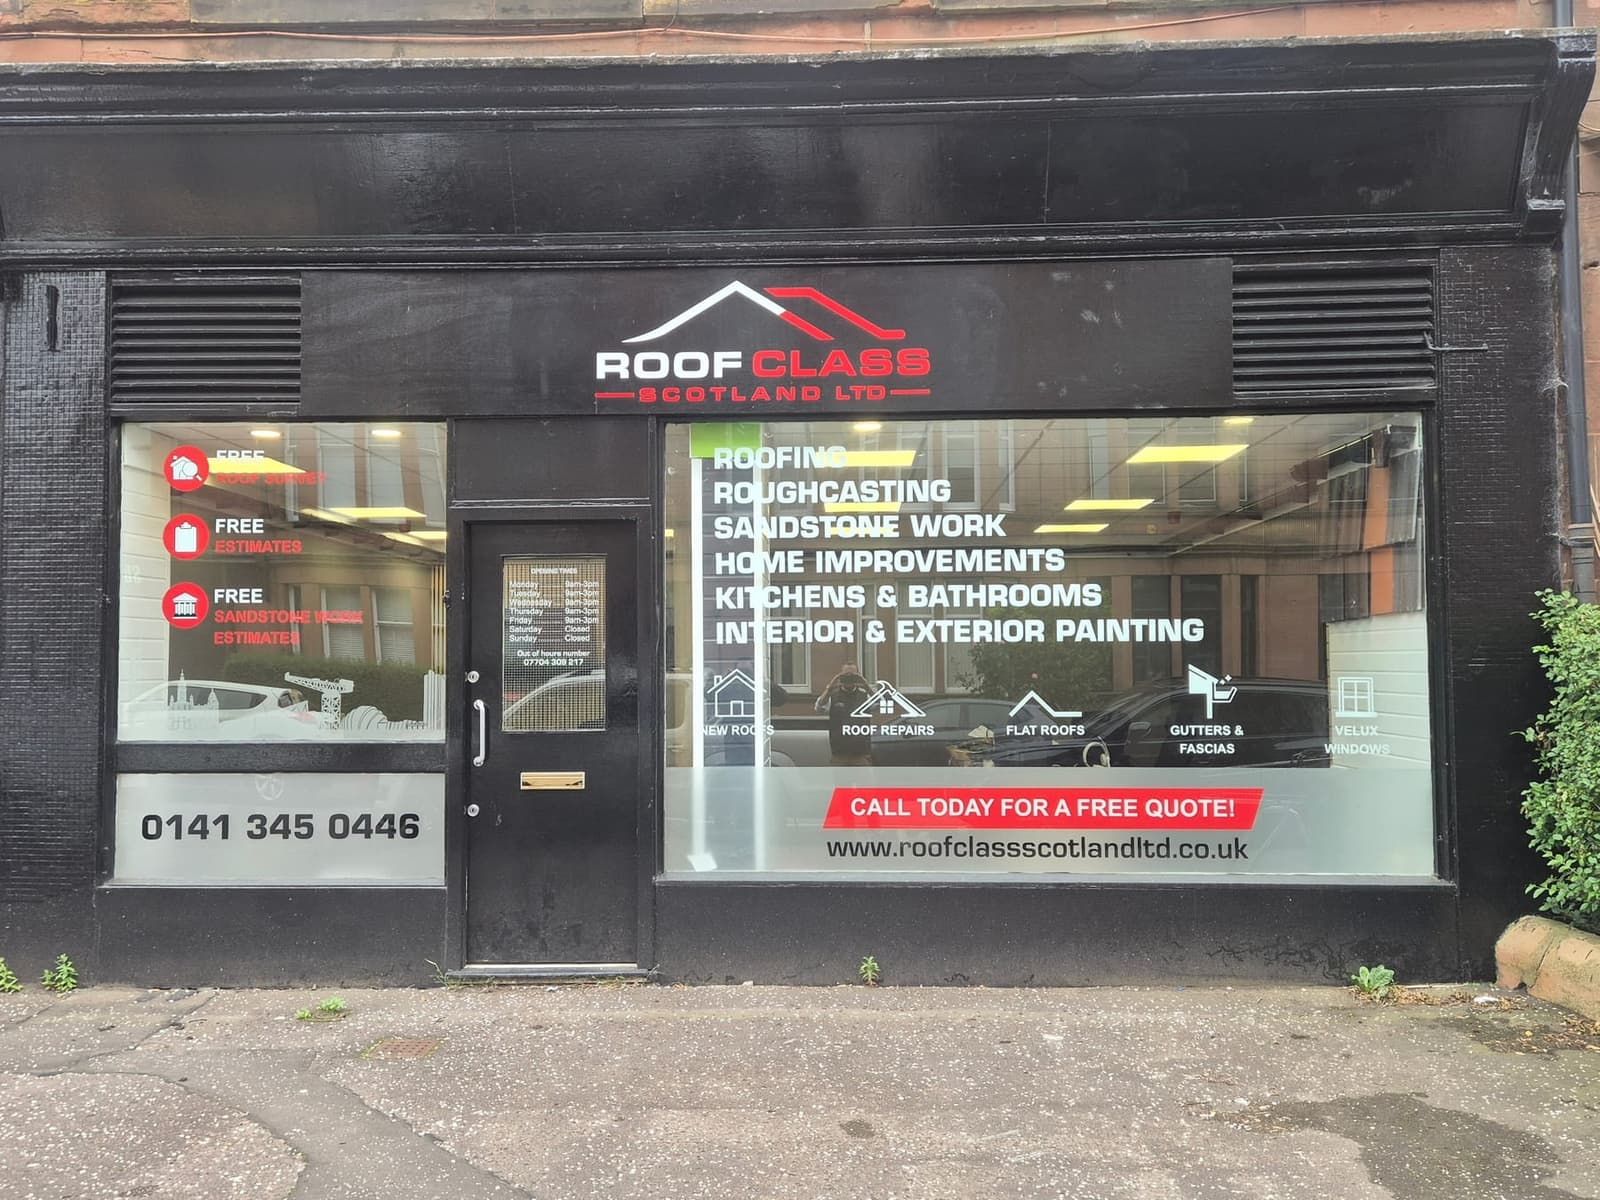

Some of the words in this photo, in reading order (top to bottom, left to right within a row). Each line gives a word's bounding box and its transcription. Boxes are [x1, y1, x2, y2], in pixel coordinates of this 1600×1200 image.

[596, 352, 742, 379] ROOF
[752, 348, 932, 377] CLASS
[639, 387, 821, 402] SCOTLAND
[836, 386, 886, 400] LTD
[216, 450, 265, 464] FREE
[714, 446, 847, 469] ROOFING
[714, 479, 951, 504] ROUGHCASTING
[215, 519, 265, 533] FREE
[714, 515, 900, 539] SANDSTONE
[911, 514, 1007, 537] WORK
[215, 540, 303, 554] ESTIMATES
[715, 551, 804, 574] HOME
[816, 548, 1065, 574] IMPROVEMENTS
[214, 589, 263, 604] FREE
[715, 585, 866, 609] KITCHENS
[877, 585, 898, 608] &
[908, 583, 1102, 608] BATHROOMS
[214, 610, 311, 624] SANDSTONE
[716, 619, 854, 644] INTERIOR
[866, 619, 886, 643] &
[897, 619, 1044, 643] EXTERIOR
[1056, 618, 1205, 642] PAINTING
[214, 632, 300, 645] ESTIMATES
[702, 725, 728, 736] NEW
[842, 725, 877, 736] ROOF
[880, 725, 935, 736] REPAIRS
[1006, 725, 1037, 736] FLAT
[1041, 725, 1085, 736] ROOFS
[1170, 725, 1232, 737] GUTTERS
[1234, 725, 1244, 736] &
[1335, 725, 1379, 736] VELUX
[1179, 743, 1235, 755] FASCIAS
[1324, 743, 1391, 755] WINDOWS
[850, 798, 911, 817] CALL
[917, 798, 994, 817] TODAY
[1001, 798, 1049, 817] FOR
[1053, 799, 1071, 816] A
[1076, 798, 1138, 817] FREE
[1145, 799, 1236, 818] QUOTE!
[142, 814, 230, 840] 0141
[246, 814, 314, 840] 345
[328, 813, 420, 839] 0446
[827, 836, 1249, 859] www.roofclassscotlandltd.co.uk
